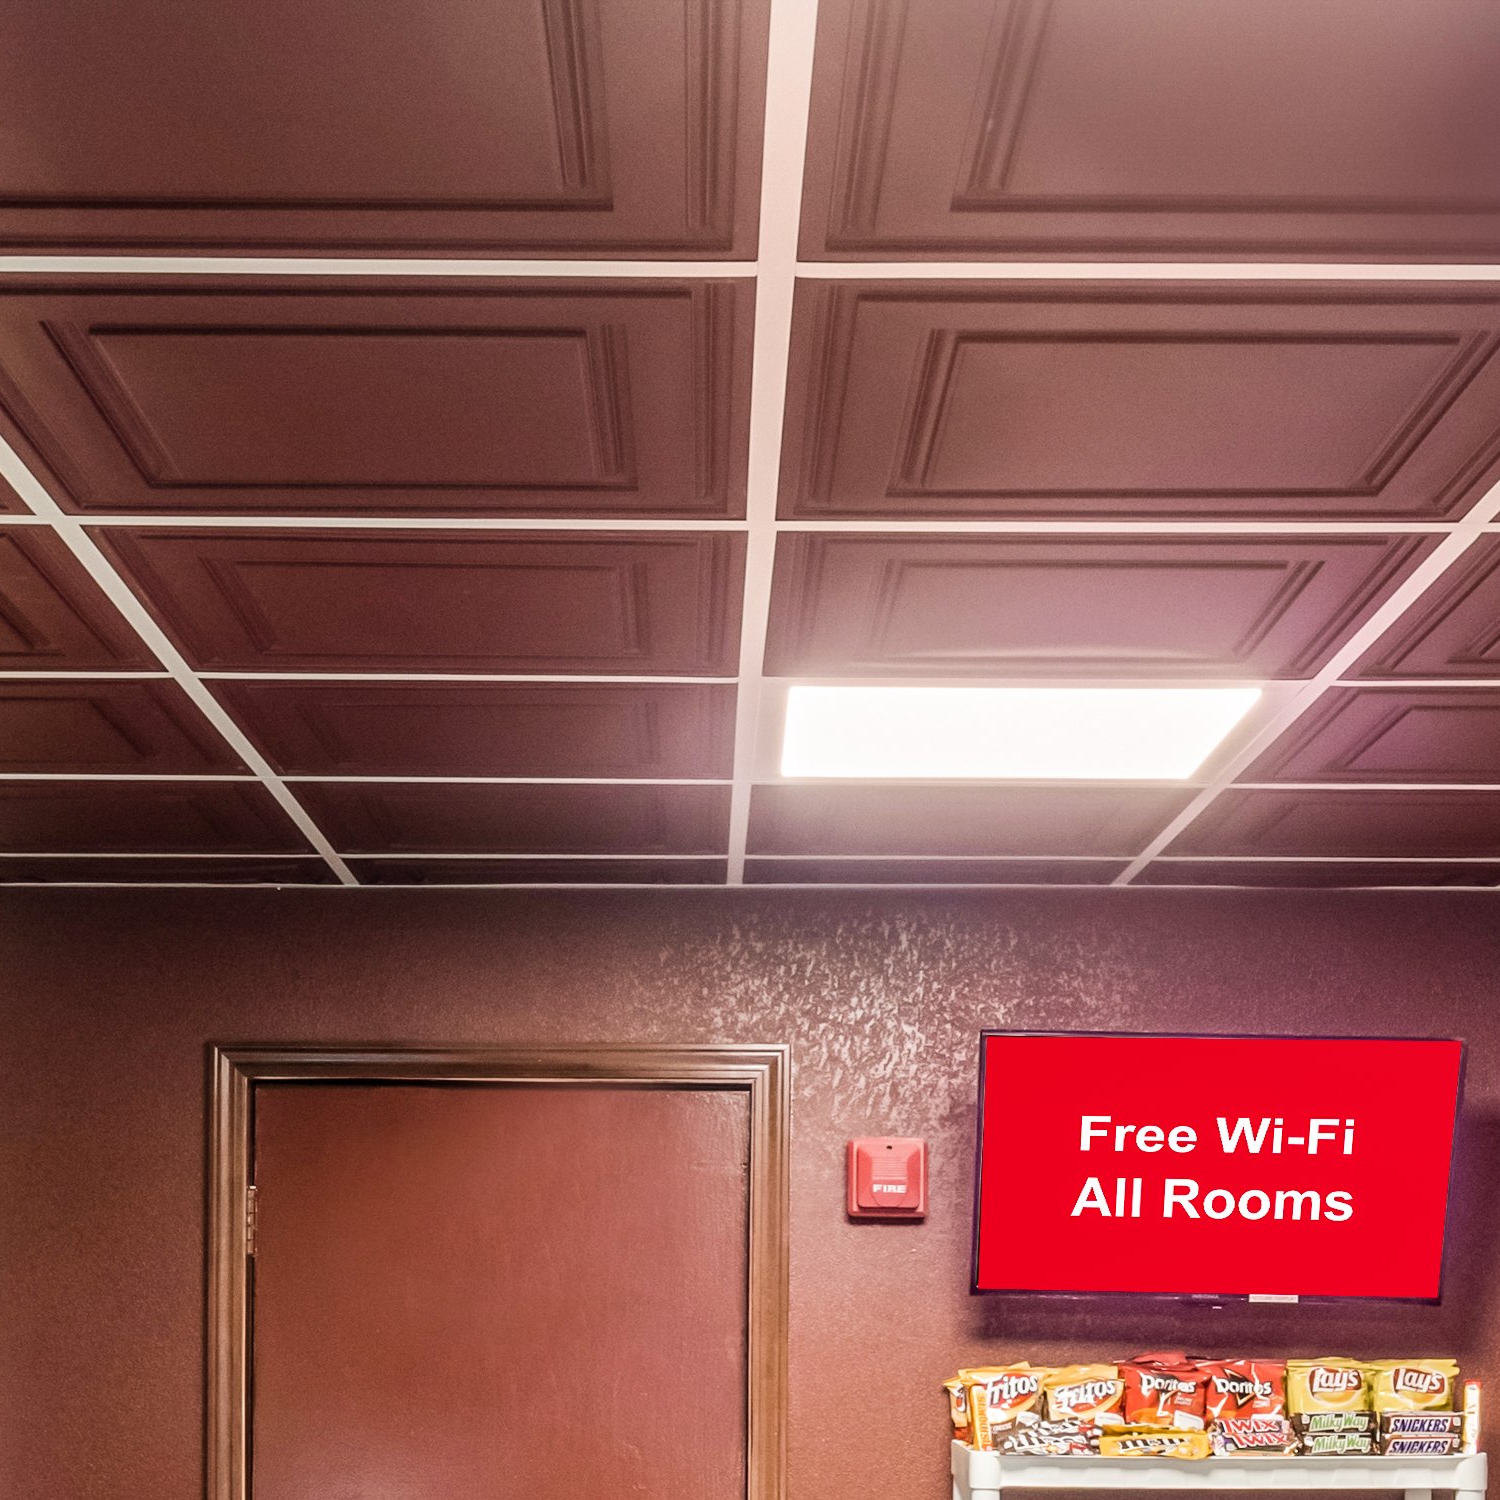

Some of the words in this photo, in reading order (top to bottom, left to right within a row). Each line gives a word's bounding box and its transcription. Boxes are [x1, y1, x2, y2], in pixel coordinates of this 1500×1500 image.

[1080, 1116, 1197, 1153] Free
[1217, 1118, 1355, 1155] Wi-Fi
[872, 1183, 907, 1194] FIRE
[1071, 1177, 1142, 1217] All
[1163, 1179, 1353, 1221] Rooms
[1213, 1376, 1272, 1395] Doritos
[1311, 1367, 1360, 1393] Lay's
[1395, 1367, 1444, 1393] Lay's
[1309, 1414, 1344, 1433] Milky
[1343, 1413, 1370, 1431] Way
[1391, 1418, 1450, 1433] SNICKERS
[1311, 1434, 1347, 1455] Milky
[1345, 1433, 1372, 1453] Way
[1389, 1440, 1449, 1455] SNICKERS
